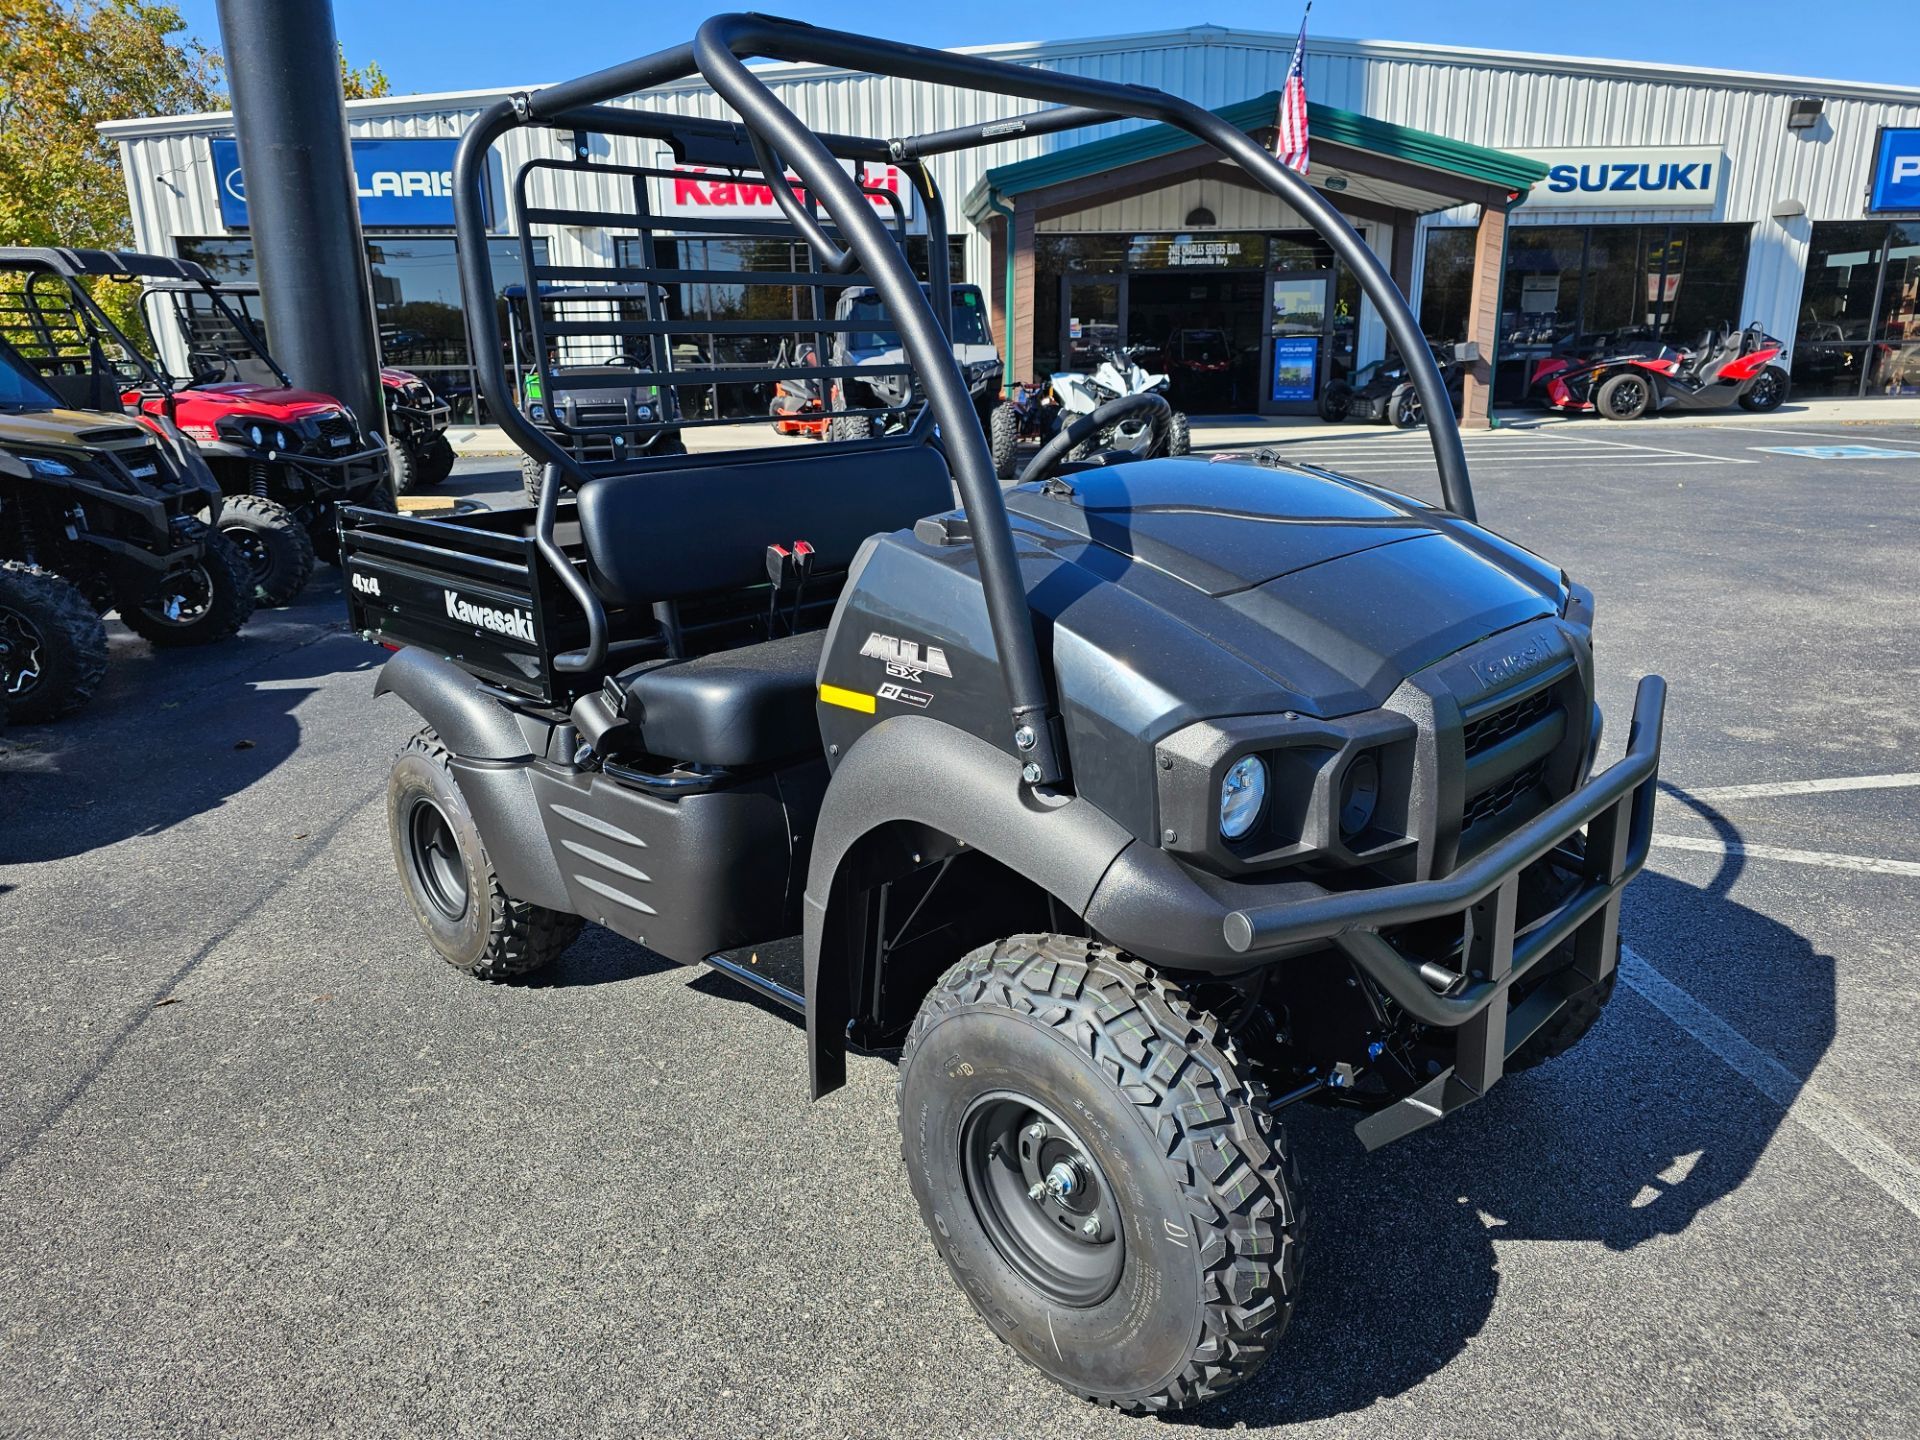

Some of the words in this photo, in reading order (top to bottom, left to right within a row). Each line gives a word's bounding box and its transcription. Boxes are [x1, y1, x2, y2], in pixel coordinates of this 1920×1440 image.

[1548, 163, 1712, 193] SUZUKI
[1181, 244, 1204, 256] CHARLES
[352, 573, 381, 597] 4x4
[444, 590, 536, 642] Kawasaki
[859, 631, 953, 678] MULE
[886, 661, 922, 683] SX
[879, 684, 899, 698] FI
